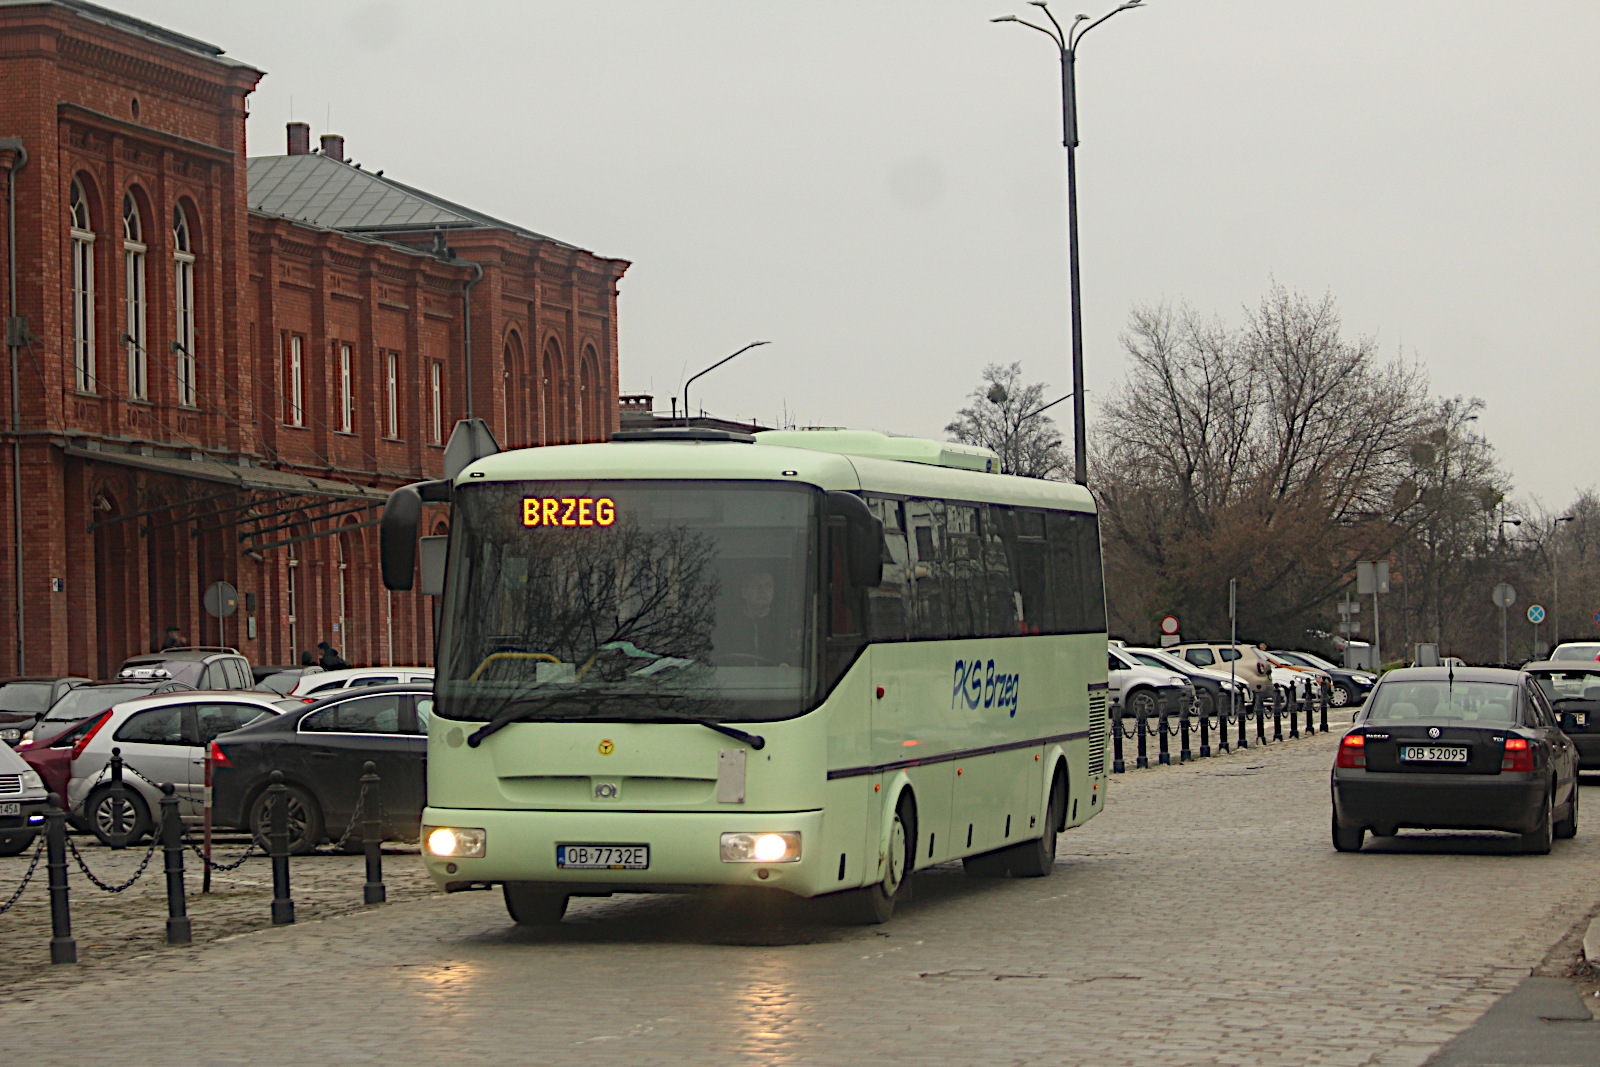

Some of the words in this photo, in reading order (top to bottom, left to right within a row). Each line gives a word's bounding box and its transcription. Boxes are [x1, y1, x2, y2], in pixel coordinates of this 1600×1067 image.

[523, 498, 615, 526] BRZEG
[952, 659, 982, 710] PKS
[984, 658, 1019, 718] Brzeg
[1407, 747, 1425, 759] OB
[1429, 748, 1466, 760] 52095
[568, 848, 588, 863] OB
[594, 848, 643, 864] 7732E
